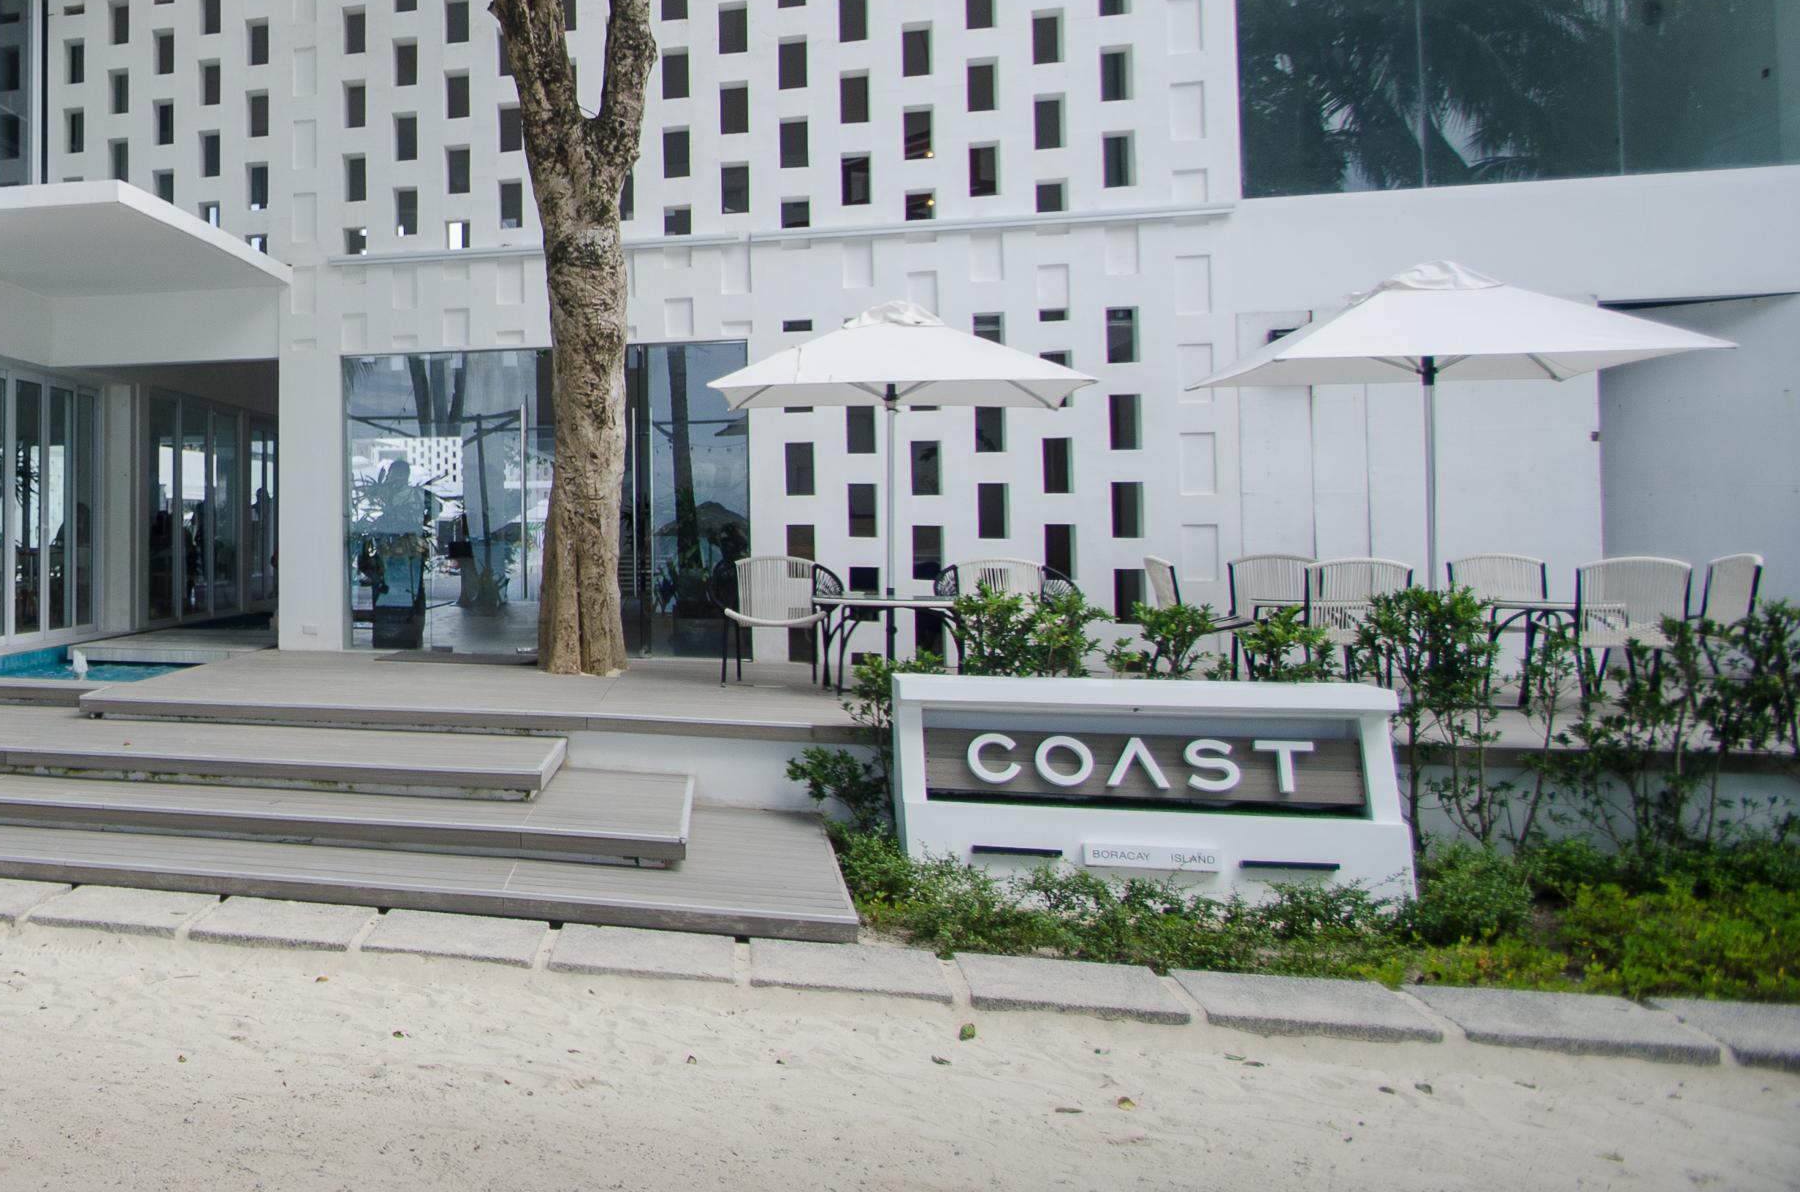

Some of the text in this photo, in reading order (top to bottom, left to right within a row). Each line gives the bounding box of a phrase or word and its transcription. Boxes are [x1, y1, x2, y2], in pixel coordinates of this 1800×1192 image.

[967, 733, 1314, 793] COAST
[1092, 849, 1216, 865] BORACAY ISLAND
